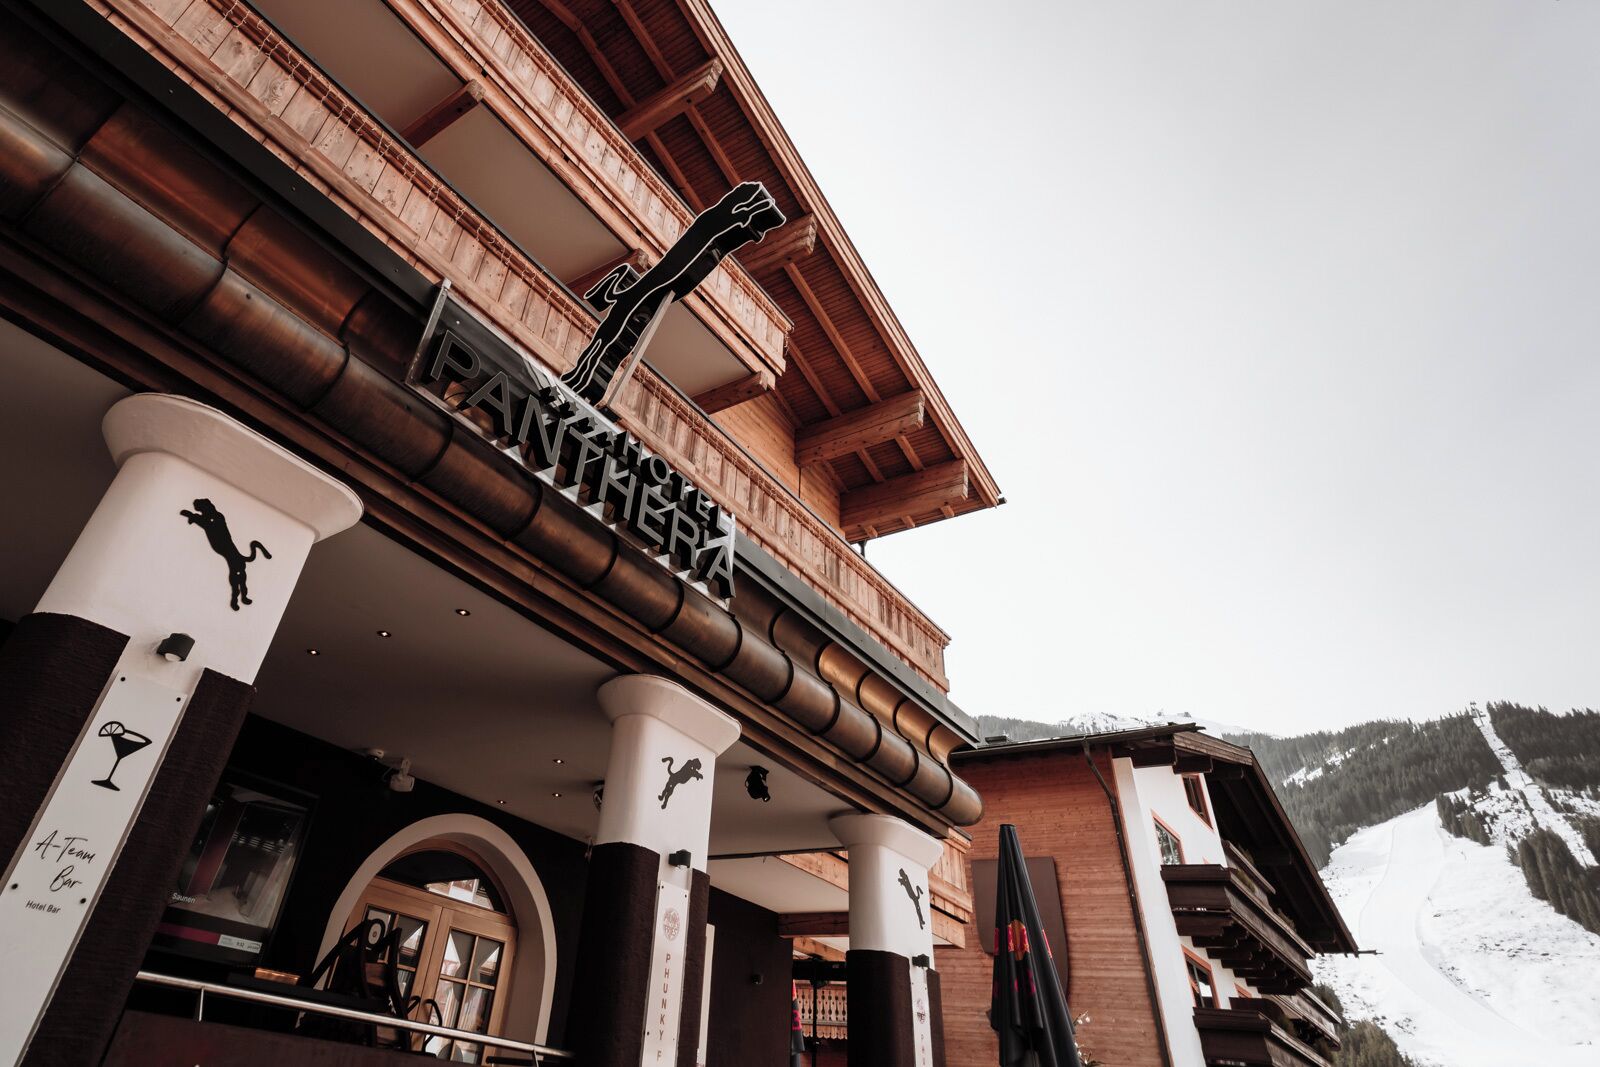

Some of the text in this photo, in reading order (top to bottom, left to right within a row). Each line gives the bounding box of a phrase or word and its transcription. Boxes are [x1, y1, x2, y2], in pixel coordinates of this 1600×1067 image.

[430, 329, 737, 599] PANTHERA
[622, 430, 729, 537] HOTEL
[35, 830, 96, 863] A-Team
[26, 900, 61, 914] Hotel Bar
[49, 865, 82, 892] Bar
[659, 953, 671, 1041] PHUNKY
